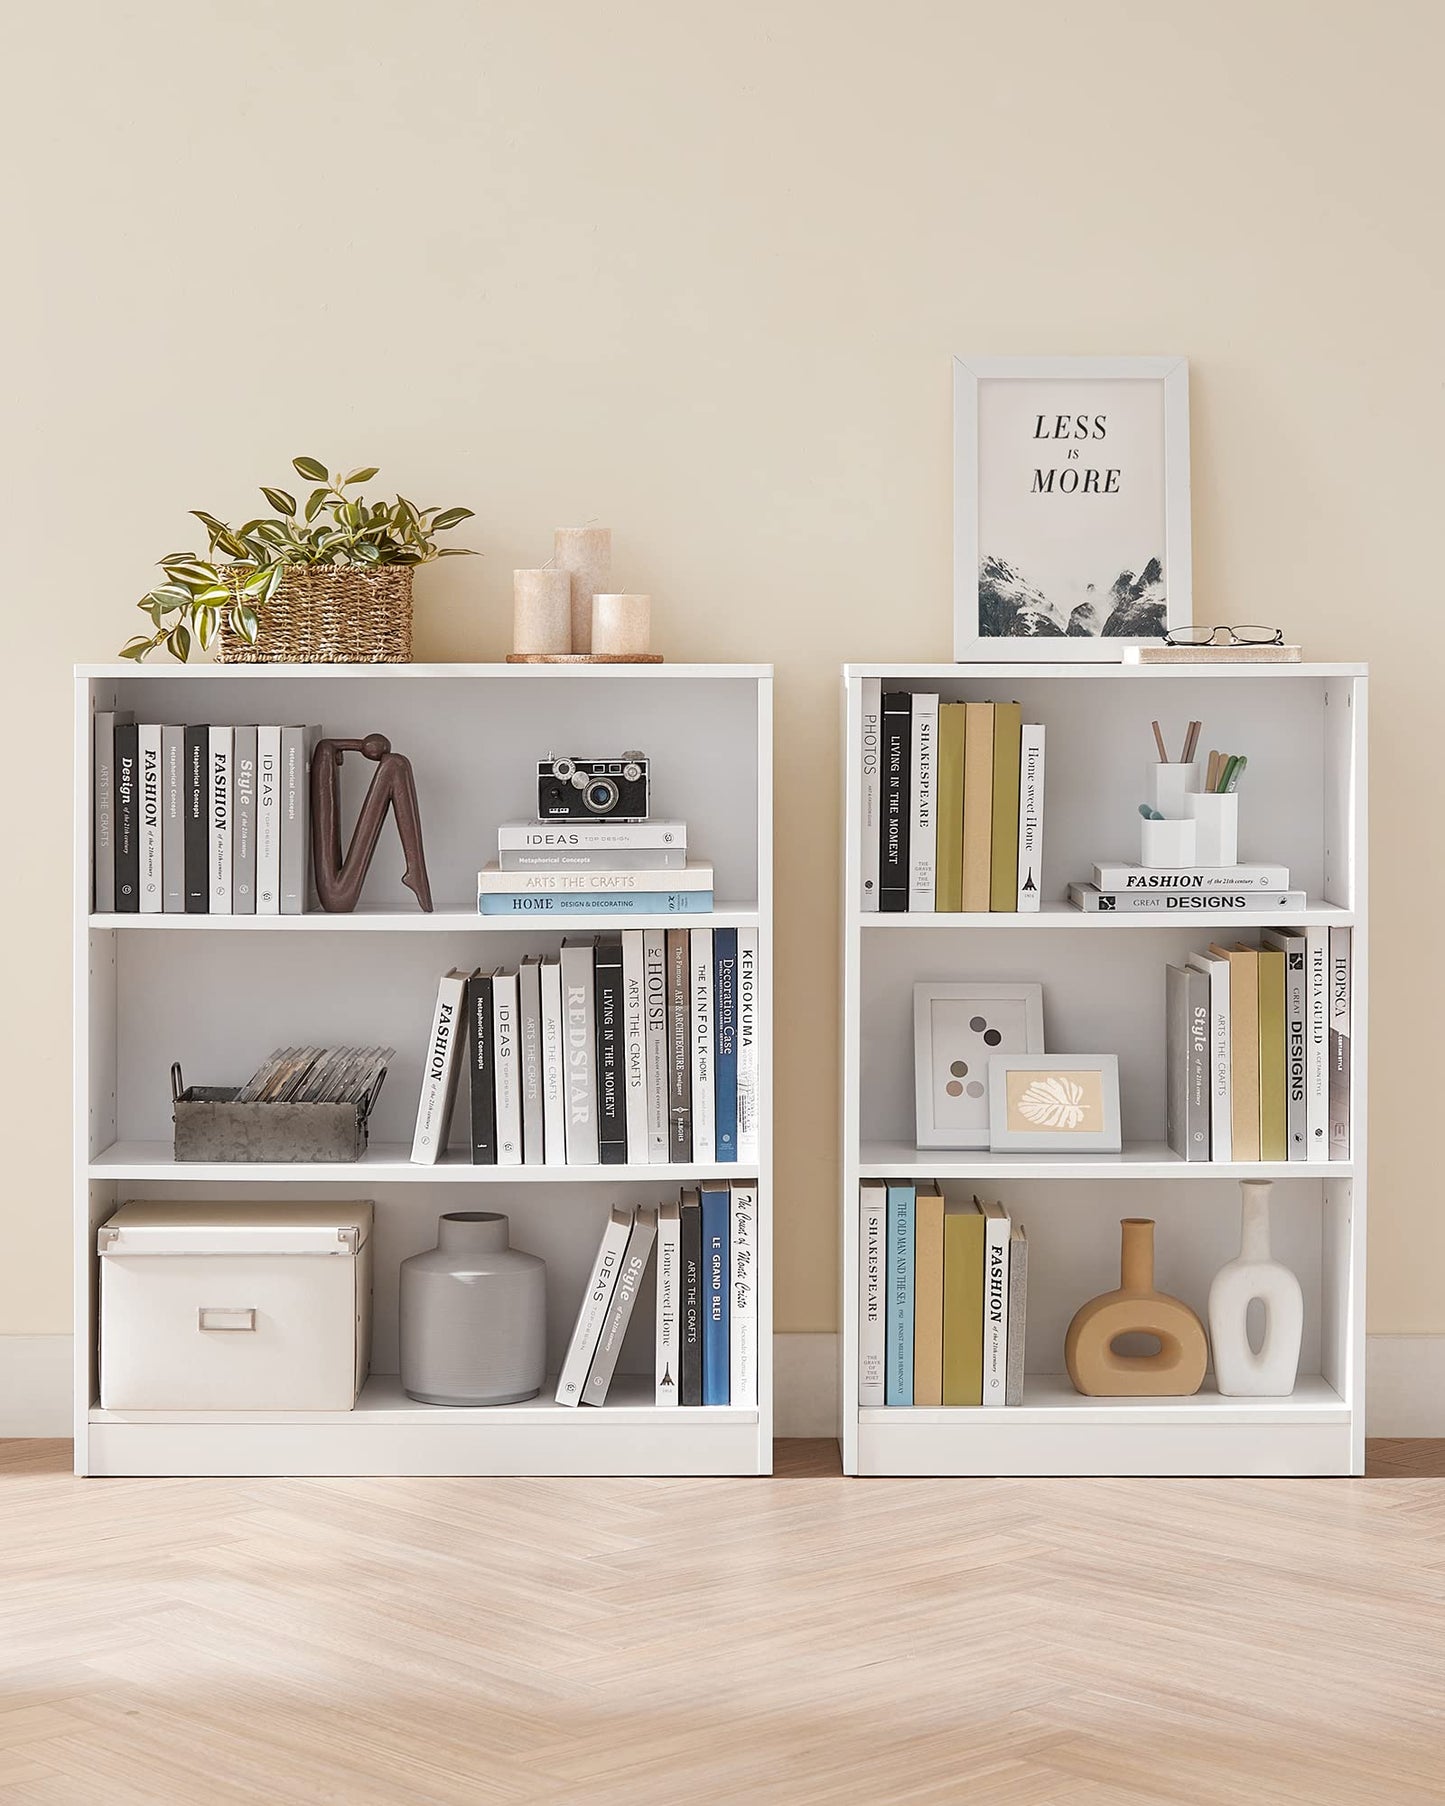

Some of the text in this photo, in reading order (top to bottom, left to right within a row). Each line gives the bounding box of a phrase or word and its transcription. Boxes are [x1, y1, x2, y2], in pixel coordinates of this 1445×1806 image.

[1032, 415, 1107, 440] LESS
[1067, 449, 1079, 459] IS
[1030, 468, 1121, 493] MORE
[864, 714, 877, 775] PHOTOS
[120, 758, 133, 804] Design
[145, 750, 157, 827] FASHION
[215, 753, 226, 830] FASHION
[238, 759, 252, 805] Style
[263, 754, 272, 806] IDEAS
[889, 735, 900, 865] LIVING IN THE MOMENT
[920, 723, 930, 828] SHAKESPEARE
[1025, 746, 1039, 851] Home sweet Home
[527, 834, 579, 844] IDEAS
[512, 899, 554, 909] HOME
[526, 876, 635, 887] ARTS THE CRAFTS
[1126, 875, 1204, 888] FASHION
[1166, 896, 1246, 908] DESIGNS
[648, 949, 662, 957] PC
[698, 964, 706, 981] THE
[648, 963, 664, 1031] HOUSE
[675, 990, 683, 1005] ART
[724, 959, 735, 1055] Decoration Case
[742, 950, 753, 1047] KENGOKUMA
[1314, 948, 1322, 1044] TRICIA GUILD
[1335, 958, 1346, 1017] HOPSCA
[430, 1003, 453, 1081] FASHION
[500, 1005, 511, 1057] IDEAS
[629, 979, 641, 1087] ARTS THE CRAFTS
[675, 1012, 685, 1070] ARCHITECTURE
[697, 986, 707, 1055] KINFOLK
[1192, 1006, 1206, 1051] Style
[477, 1040, 485, 1070] Concepts
[526, 1017, 537, 1099] ARTS THE CRAFTS
[547, 1018, 557, 1100] ARTS THE CRAFTS
[567, 986, 589, 1125] REDSTAR
[604, 989, 615, 1117] LIVING IN THE MOMENT
[699, 1057, 707, 1082] HOME
[1217, 1014, 1226, 1096] ARTS THE CRAFTS
[1291, 1021, 1303, 1101] DESIGNS
[735, 1212, 752, 1236] Count
[737, 1195, 752, 1210] The
[897, 1202, 906, 1217] THE
[897, 1219, 906, 1235] OLD
[733, 1238, 750, 1246] of
[737, 1250, 751, 1279] Monte
[897, 1237, 906, 1255] MAN
[897, 1256, 906, 1274] AND
[593, 1250, 616, 1302] IDEAS
[620, 1256, 642, 1301] Style
[663, 1242, 674, 1346] Home sweet Home
[712, 1237, 720, 1320] LE GRAND BLEU
[735, 1282, 751, 1308] Cristo
[868, 1217, 878, 1322] SHAKESPEARE
[896, 1275, 906, 1291] THE
[990, 1245, 1003, 1323] FASHION
[688, 1260, 696, 1343] ARTS THE CRAFTS
[896, 1291, 905, 1304] SEA
